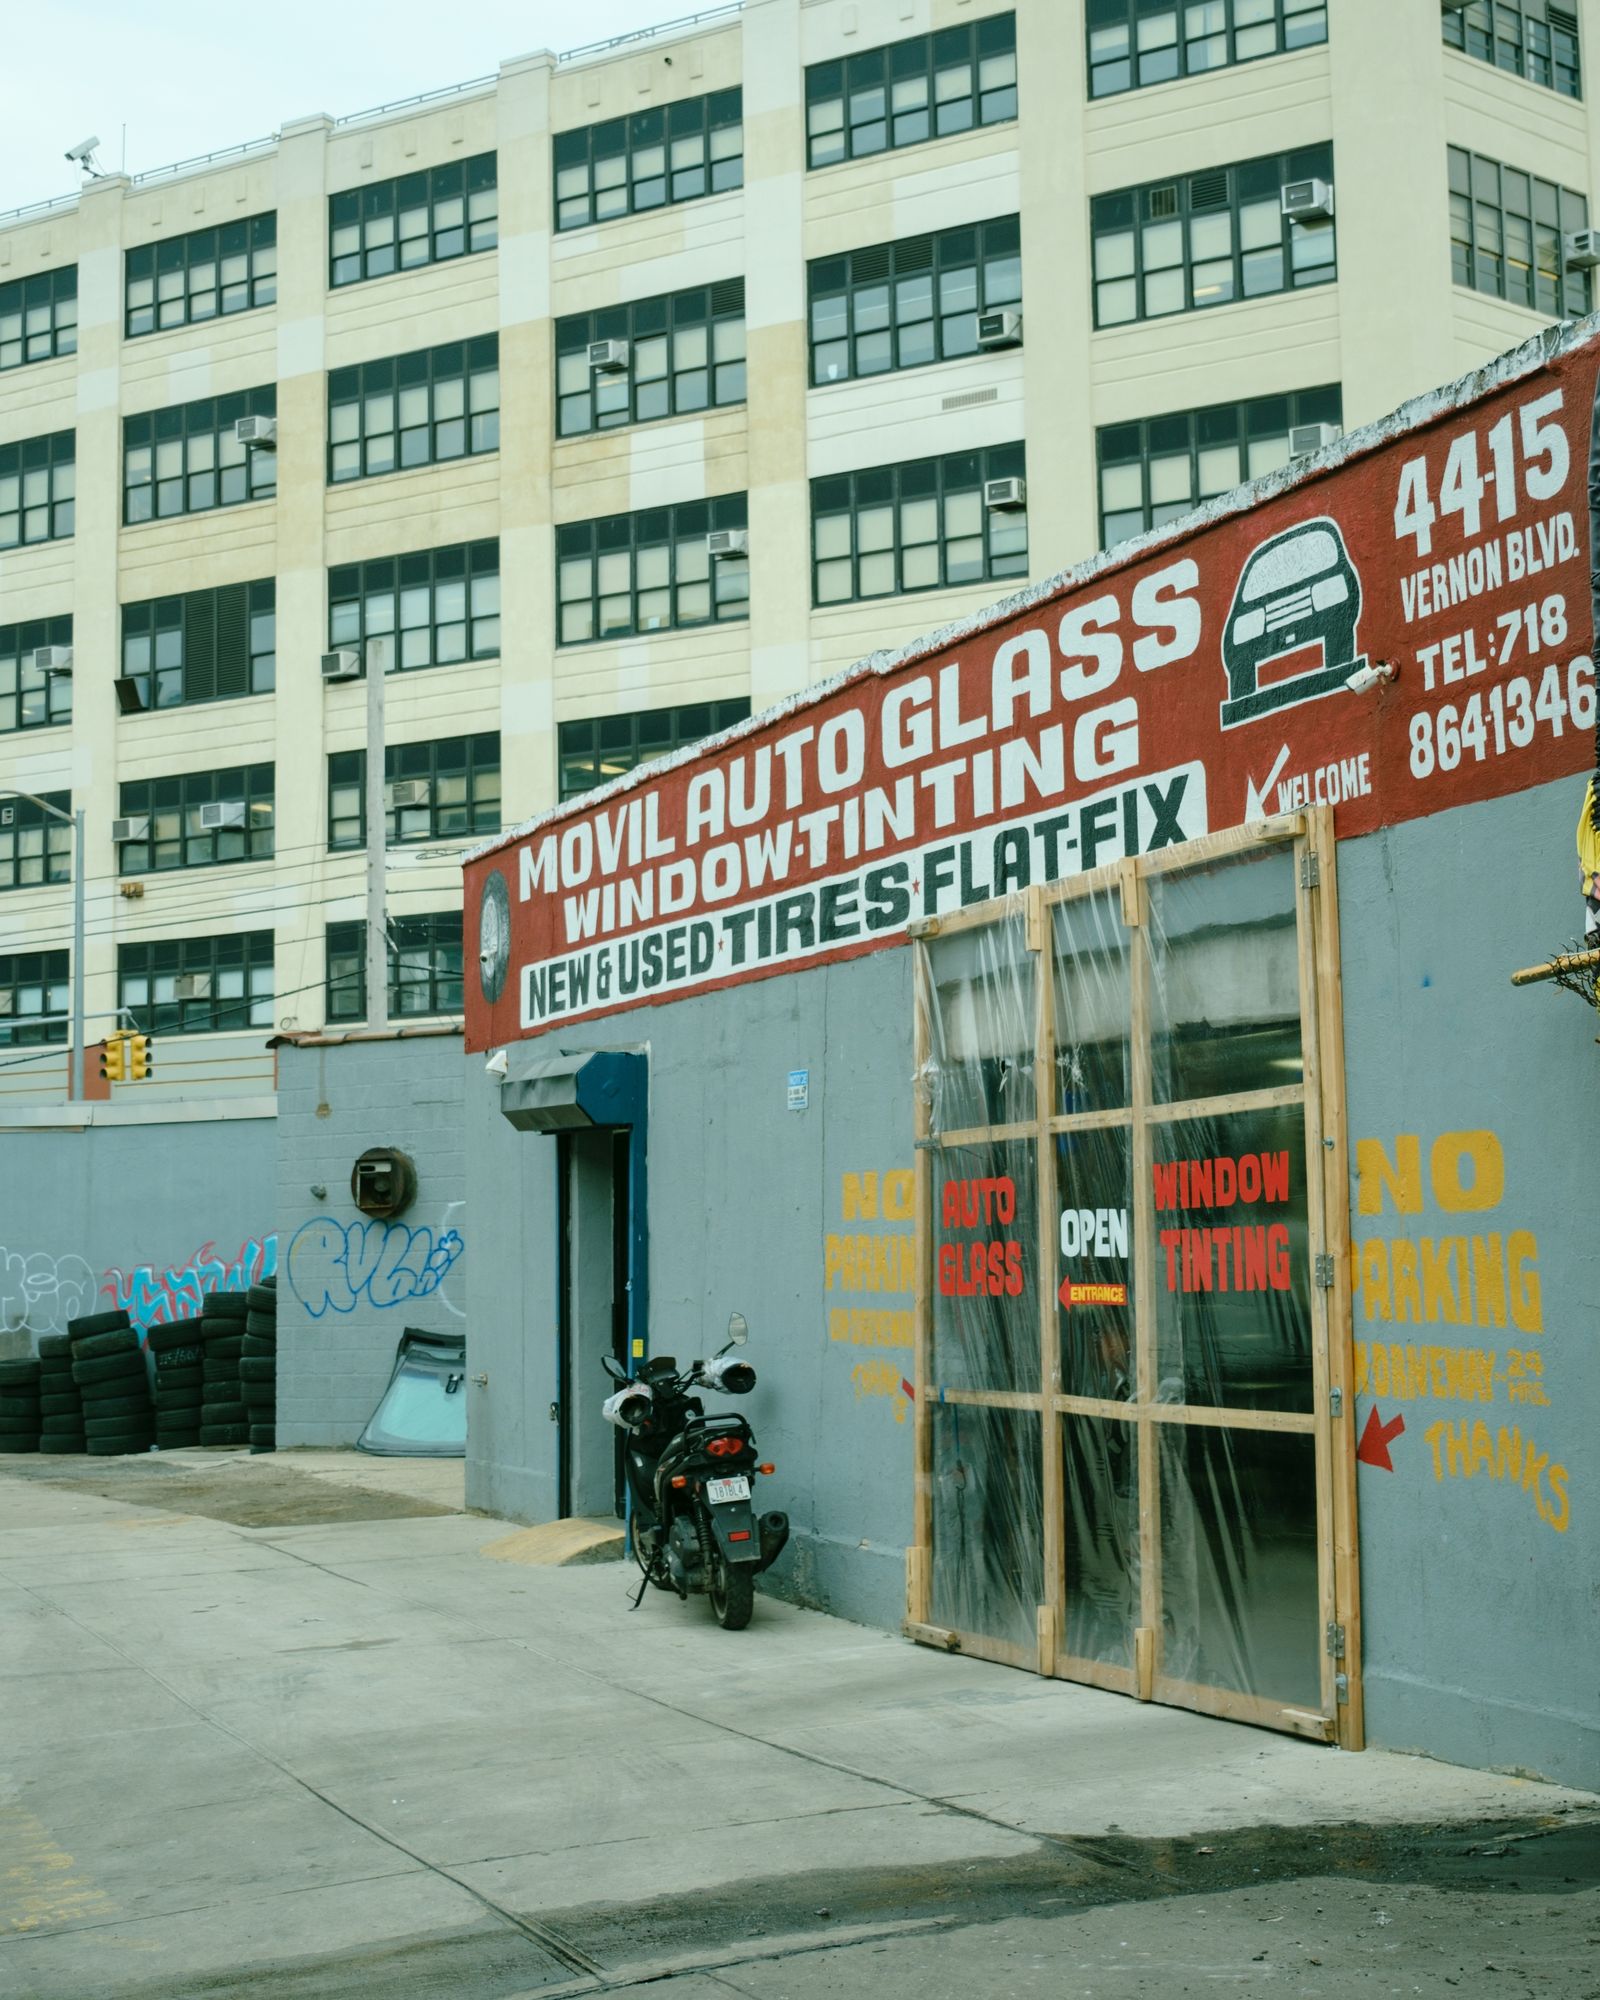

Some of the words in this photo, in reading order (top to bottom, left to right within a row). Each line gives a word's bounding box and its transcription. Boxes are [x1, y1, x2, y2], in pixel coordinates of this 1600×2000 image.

[1394, 388, 1571, 557] 44-15
[1401, 549, 1501, 623] VERNON
[1508, 512, 1580, 583] BLVD.
[519, 791, 675, 902] MOVIL
[686, 709, 866, 847] AUTO
[881, 558, 1201, 769] GLASS
[1409, 656, 1597, 779] 864-1346
[1277, 752, 1372, 813] WELCOME
[529, 954, 594, 1020] NEW
[618, 921, 714, 995] USED
[723, 862, 910, 967] TIRES
[842, 1168, 915, 1221] NO
[943, 1176, 1015, 1229] AUTO
[1153, 1150, 1289, 1210] WINDOW
[1356, 1129, 1505, 1216] NO
[826, 1234, 915, 1292] PARKIN
[1060, 1208, 1128, 1258] OPEN
[1161, 1224, 1291, 1293] TINTING
[939, 1241, 1024, 1297] GLASS
[1070, 1286, 1124, 1303] ENTRANCE
[1351, 1229, 1545, 1333] ARKING
[1424, 1417, 1570, 1533] THANKS
